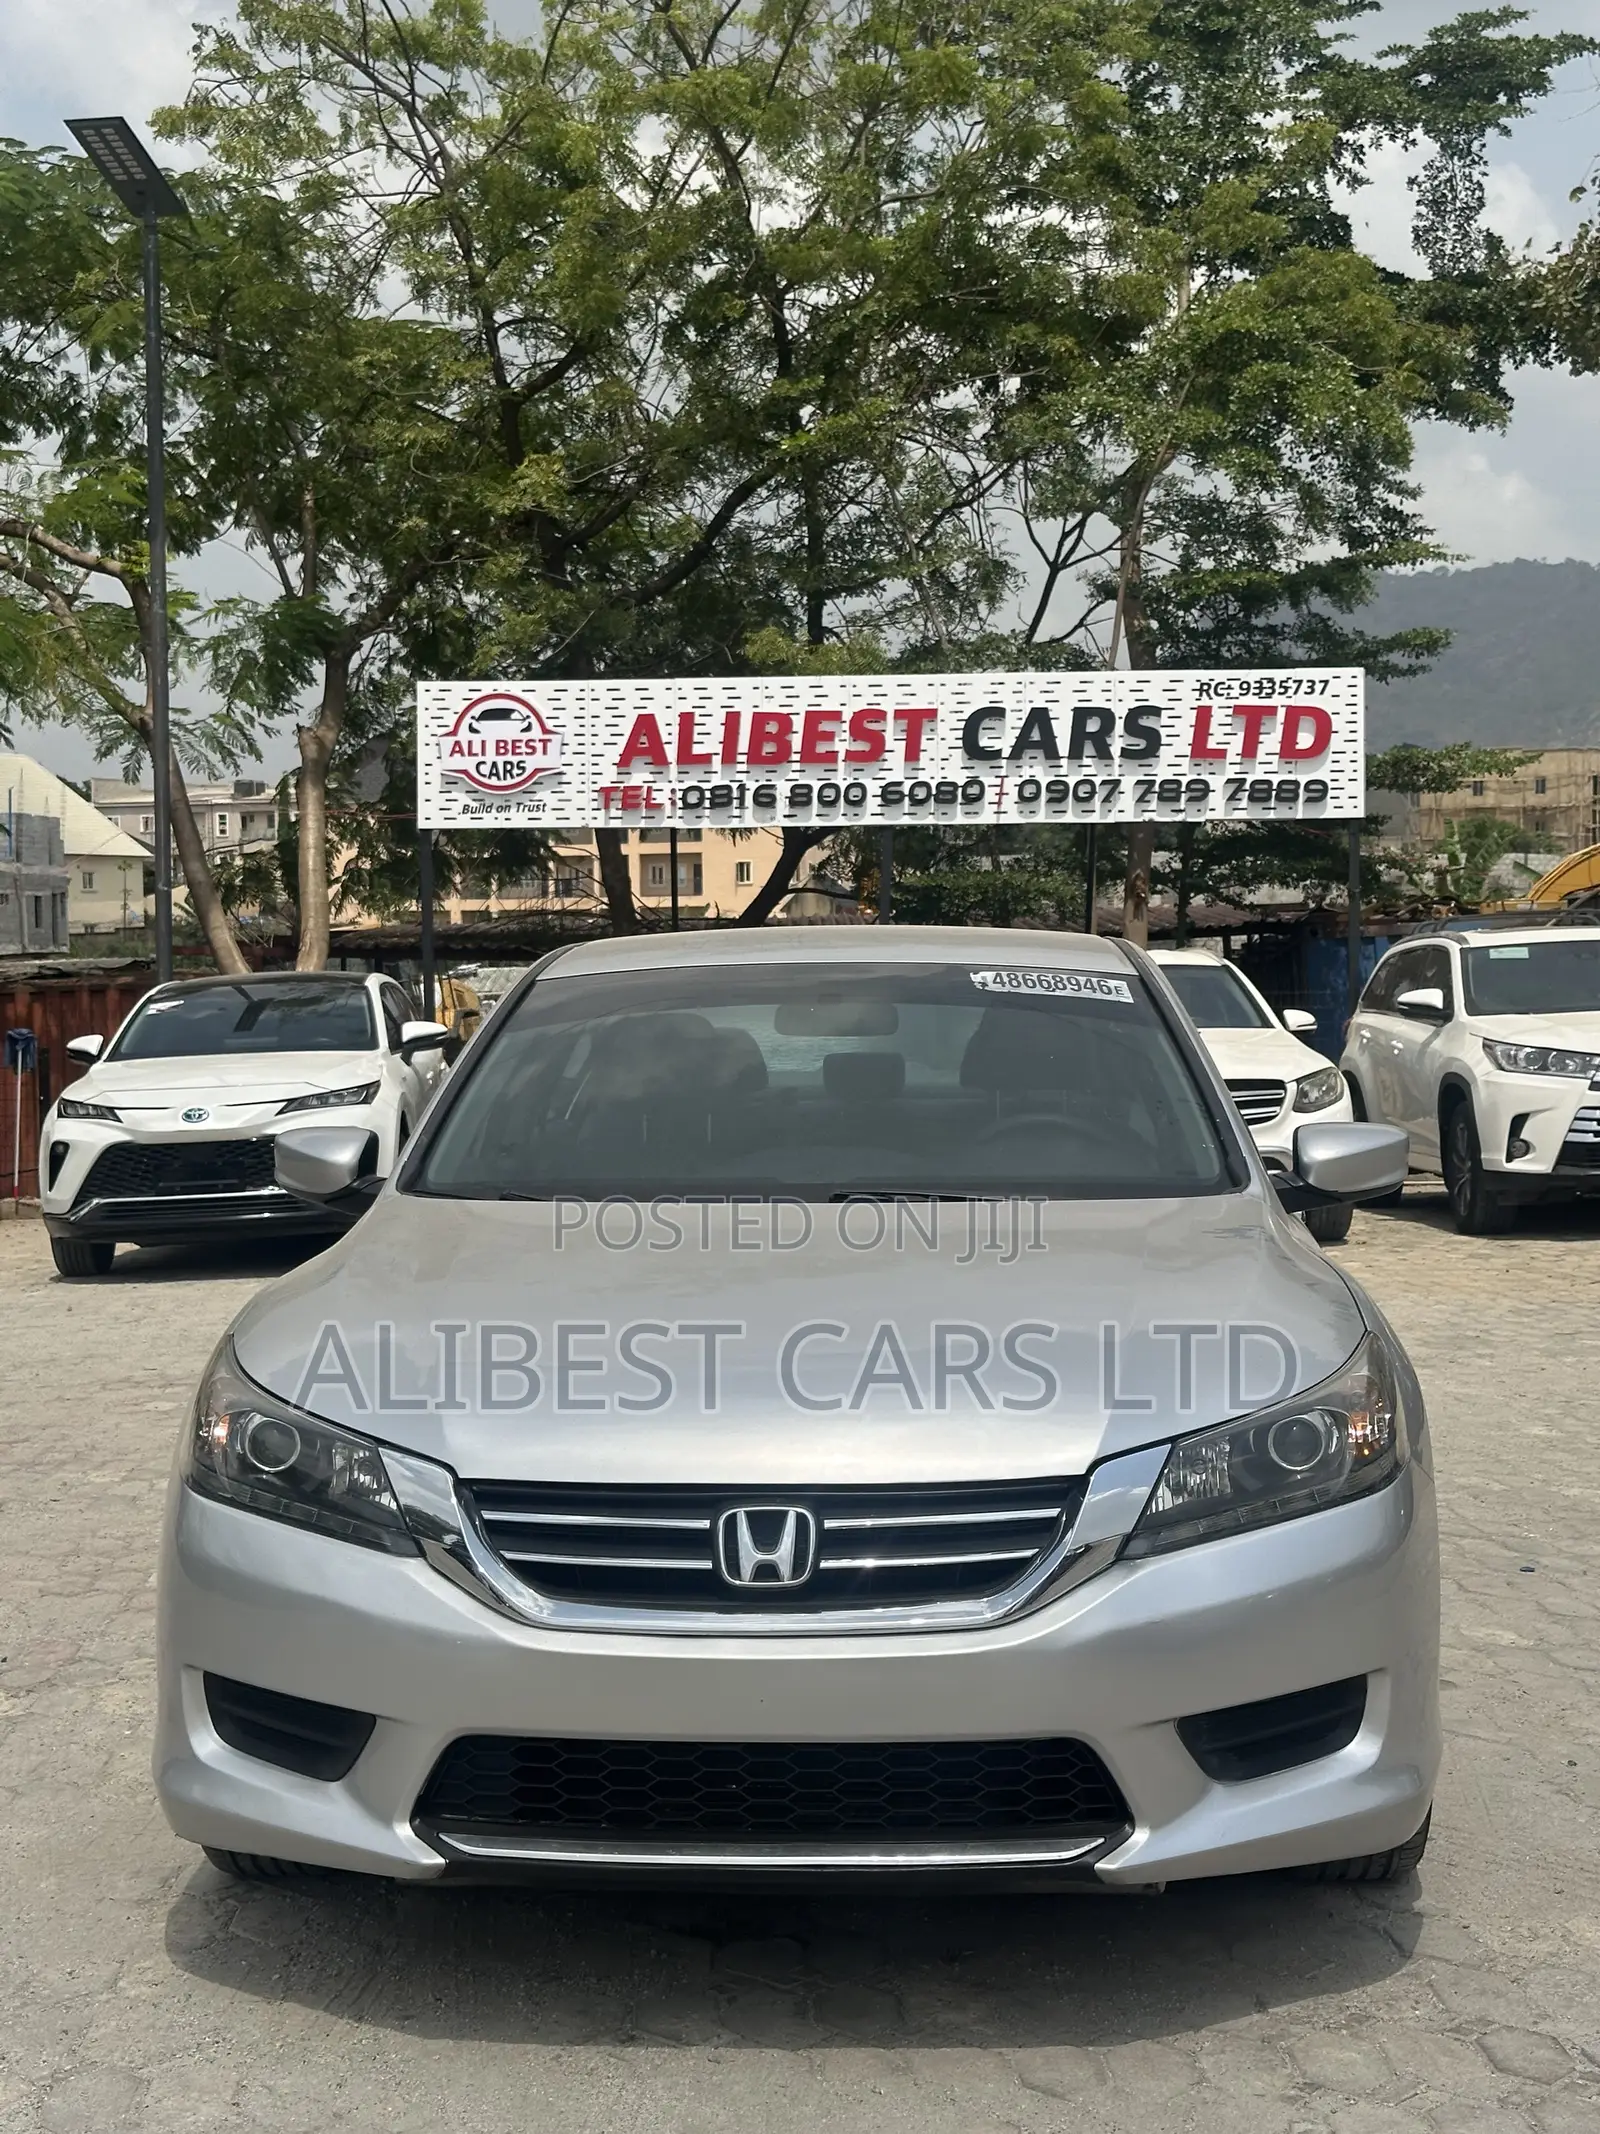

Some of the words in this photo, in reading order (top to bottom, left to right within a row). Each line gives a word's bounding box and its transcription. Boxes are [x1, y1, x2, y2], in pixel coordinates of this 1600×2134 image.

[1238, 679, 1330, 697] 9335737
[617, 708, 938, 768] ALIBEST
[962, 705, 1163, 761] CARS
[1190, 705, 1334, 760] LTD
[448, 739, 487, 757] ALI
[495, 738, 553, 757] BEST
[475, 760, 527, 780] CARS
[681, 783, 777, 810] 0816
[788, 782, 867, 808] 800
[880, 779, 985, 805] 6080
[1018, 778, 1121, 803] 0907
[1133, 778, 1211, 803] 789
[1223, 778, 1329, 803] 7889
[496, 804, 512, 813] on
[516, 802, 548, 813] Trust
